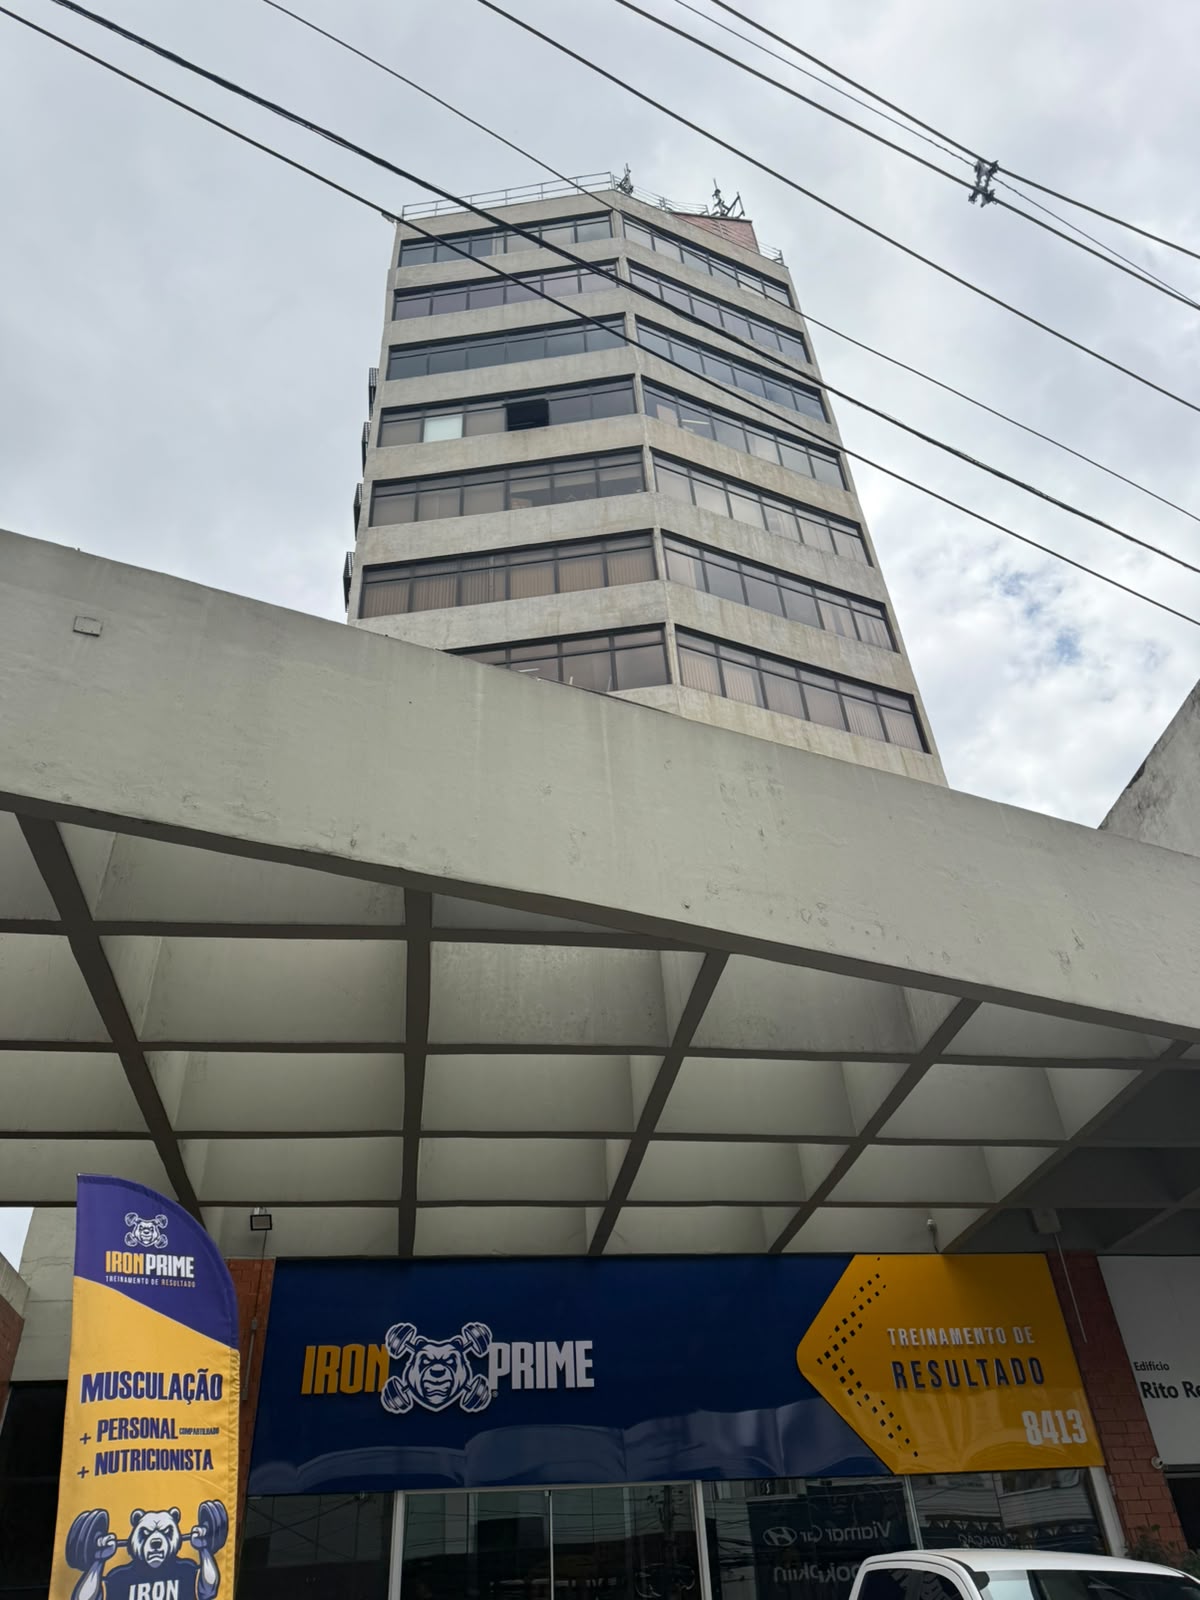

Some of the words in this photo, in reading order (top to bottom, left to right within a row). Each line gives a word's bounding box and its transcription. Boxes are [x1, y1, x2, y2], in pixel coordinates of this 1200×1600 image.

[105, 1276, 150, 1285] TREINAMENTO
[150, 1278, 159, 1286] DE
[161, 1278, 196, 1288] RESULTADO
[887, 1327, 1007, 1346] TREINAMENTO
[1012, 1326, 1035, 1344] DE
[301, 1344, 390, 1395] IRON
[488, 1340, 595, 1390] PRIME
[891, 1357, 1045, 1390] RESULTADO
[80, 1368, 223, 1405] MUSCULAÇÃO
[1140, 1381, 1179, 1399] Rito
[96, 1417, 178, 1443] PERSONAL
[1021, 1409, 1088, 1446] 8413
[95, 1448, 214, 1477] NUTRICIONISTA
[128, 1579, 179, 1600] IRON
